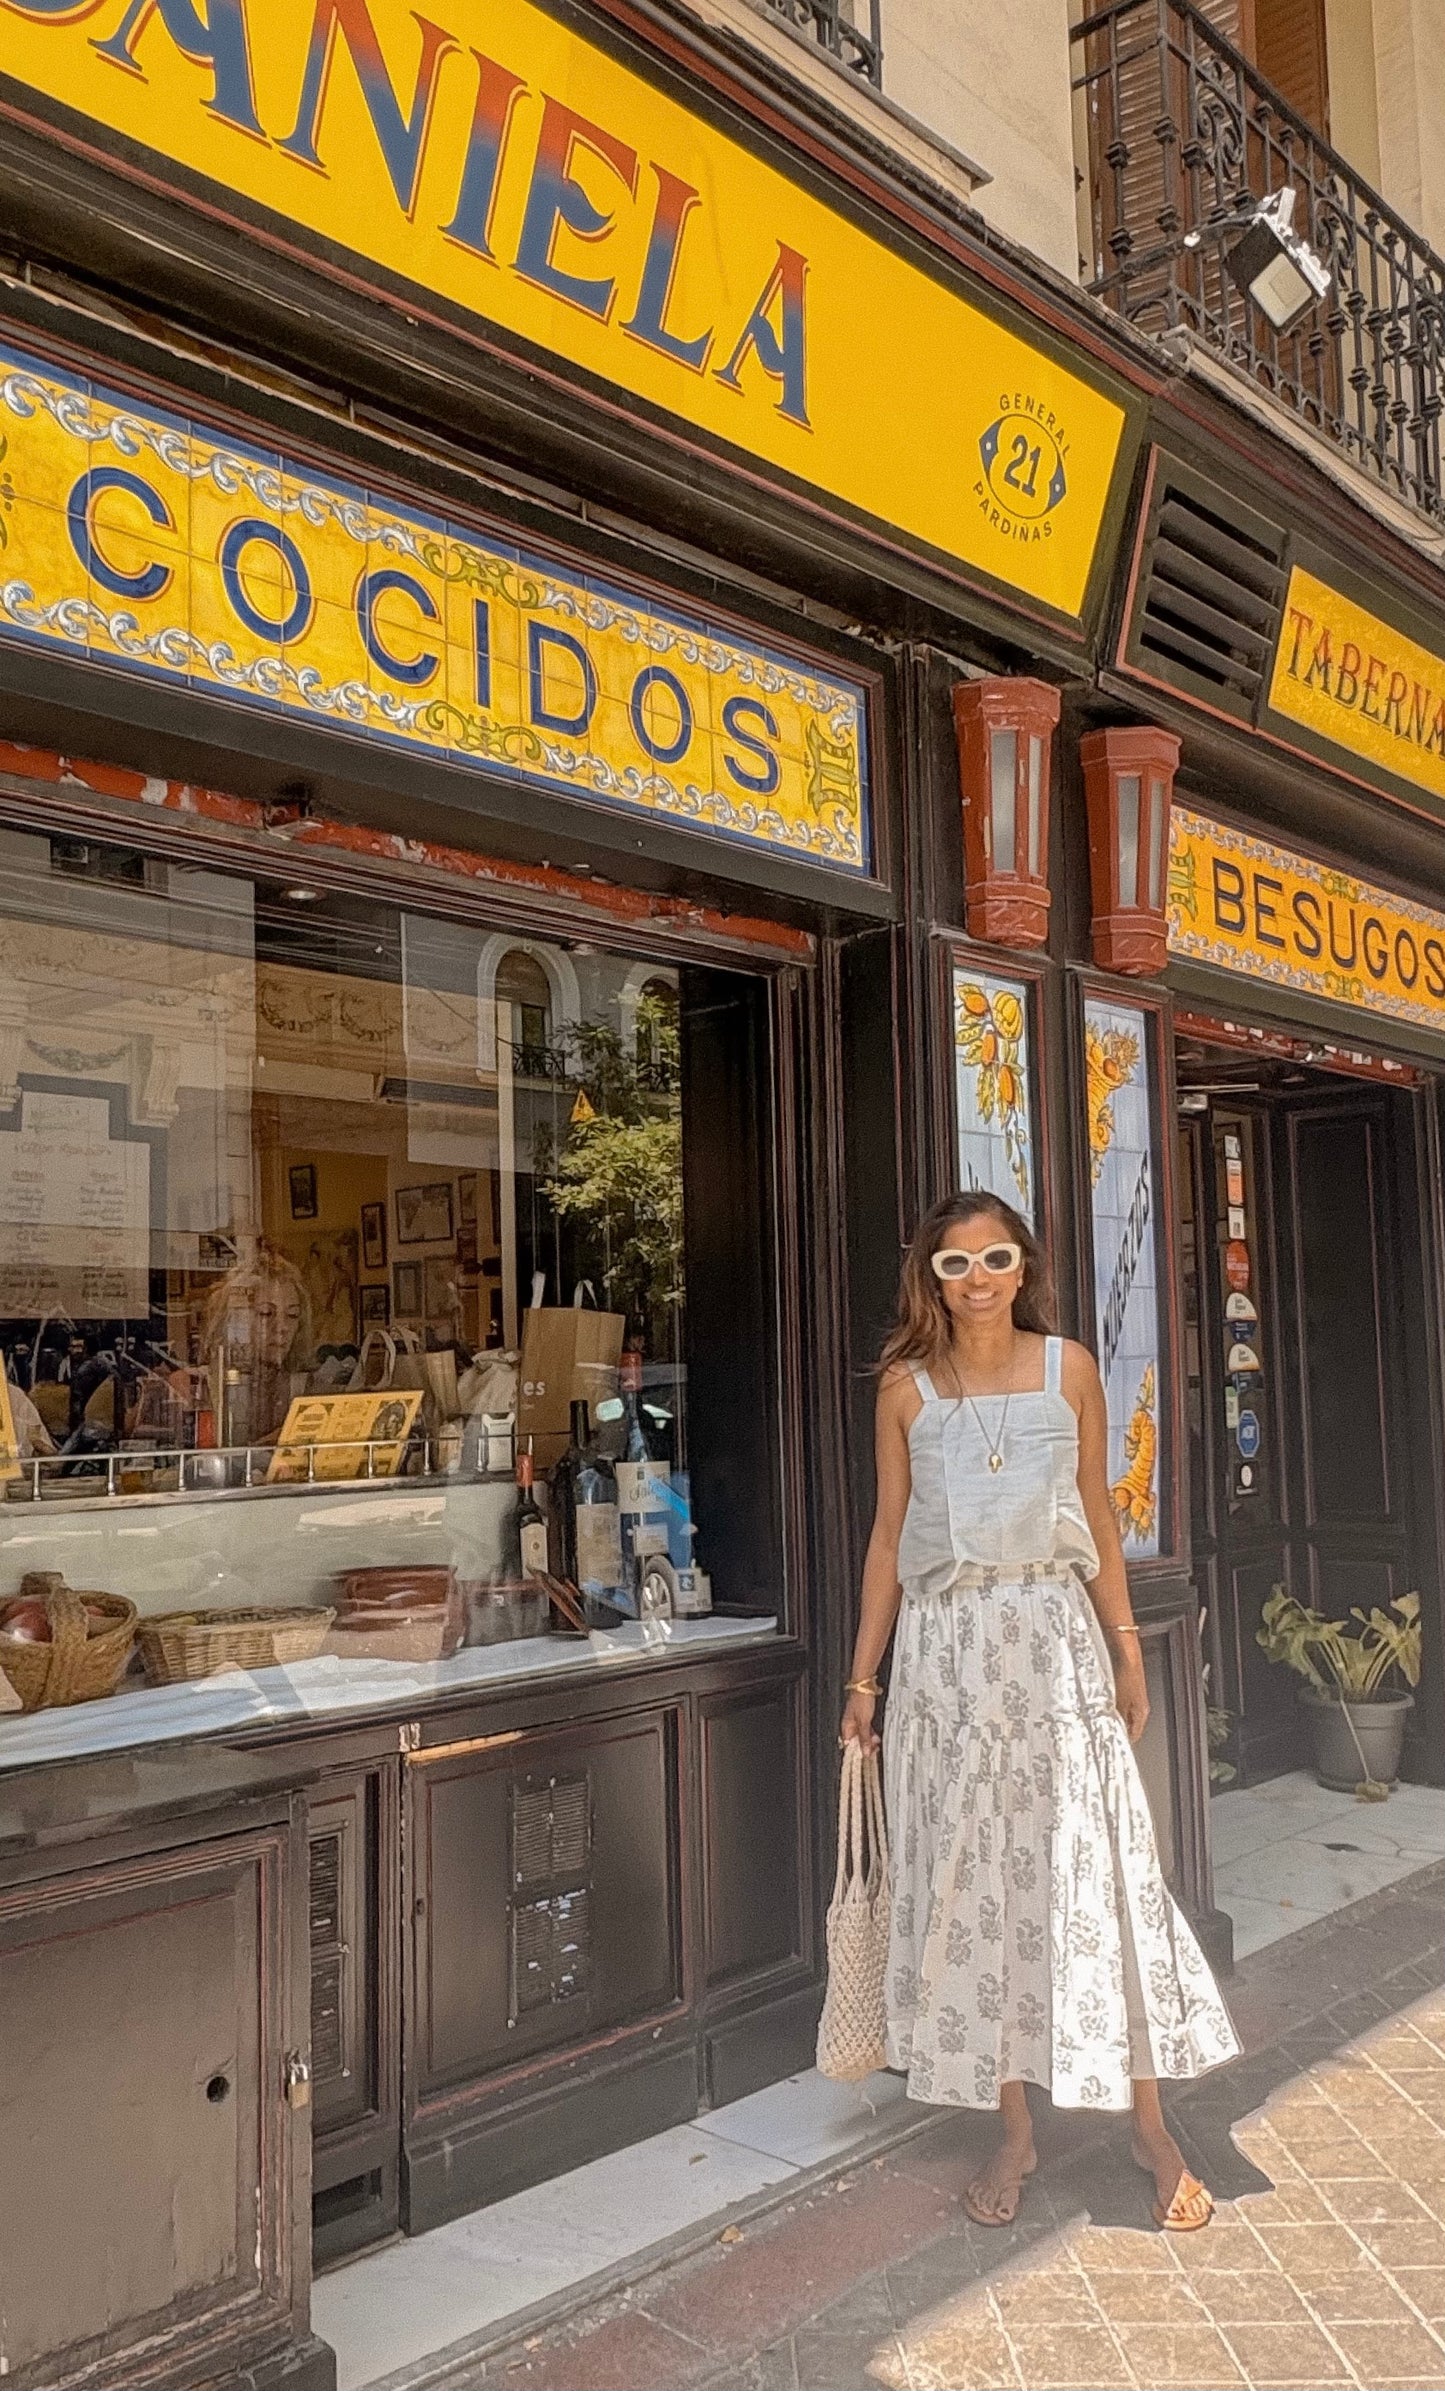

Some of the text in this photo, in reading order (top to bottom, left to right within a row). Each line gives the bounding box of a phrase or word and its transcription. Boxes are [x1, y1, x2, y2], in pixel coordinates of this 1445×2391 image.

[0, 0, 814, 434] ANIELA
[1000, 392, 1070, 459] GENERAL
[1003, 434, 1041, 498] 21
[973, 480, 1053, 542] PARDIÑAS
[66, 466, 784, 796] COCIDOS
[1212, 856, 1445, 999] BESUGOS
